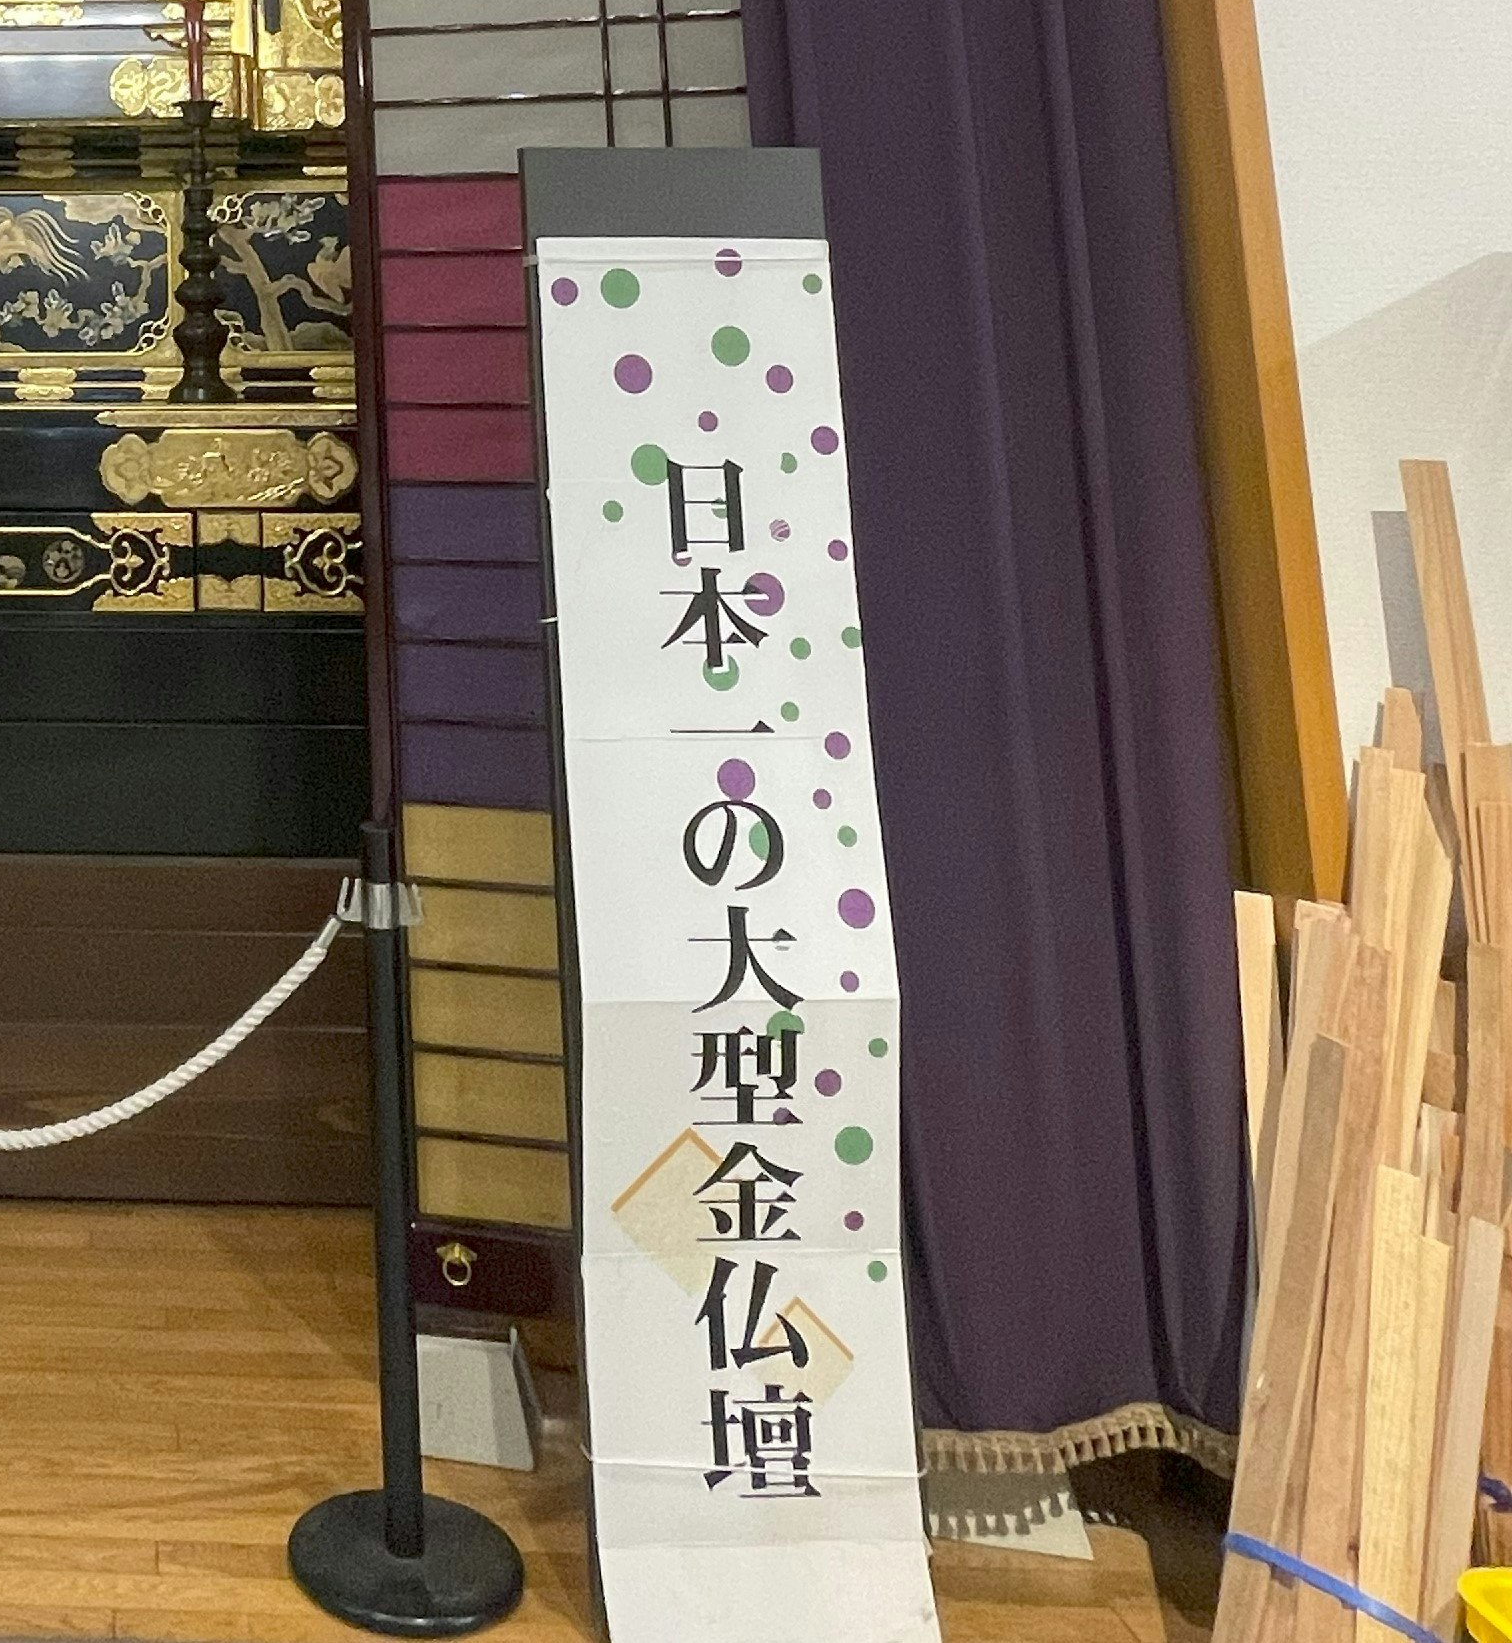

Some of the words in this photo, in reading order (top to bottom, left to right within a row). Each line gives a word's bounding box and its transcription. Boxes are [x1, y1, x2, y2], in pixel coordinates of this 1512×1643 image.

[659, 459, 822, 1497] 日本一の大型金仏壇
